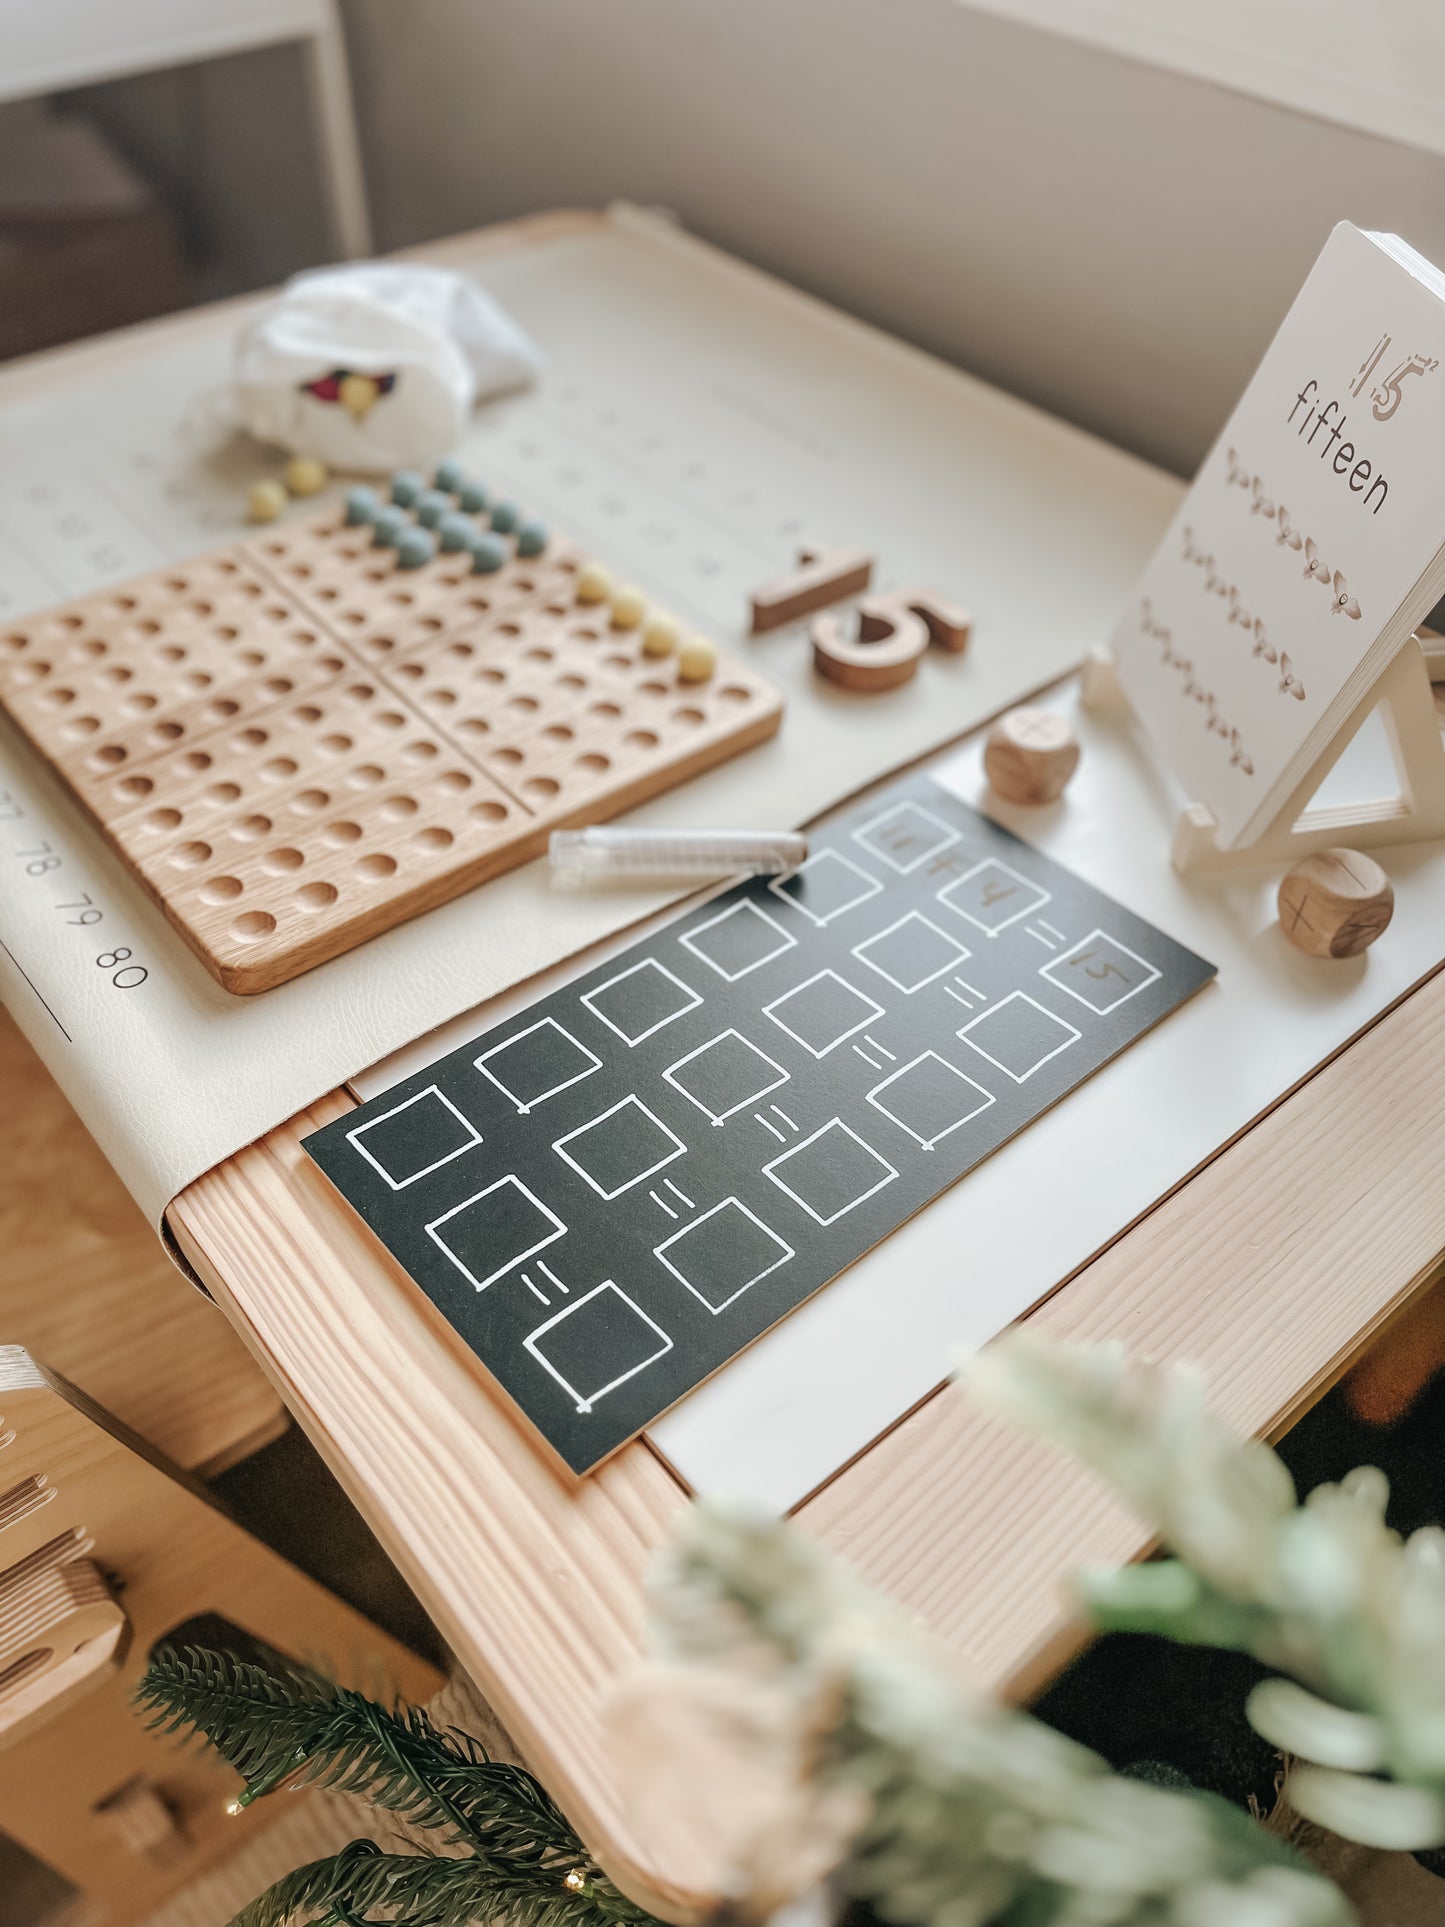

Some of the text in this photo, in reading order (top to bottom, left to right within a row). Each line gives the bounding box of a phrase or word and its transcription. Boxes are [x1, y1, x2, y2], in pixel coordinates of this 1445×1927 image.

[1353, 337, 1425, 421] 15
[1286, 380, 1389, 515] fifteen
[15, 840, 62, 877] 78
[54, 892, 103, 926] 79
[96, 947, 148, 989] 80
[1070, 950, 1130, 982] 15
